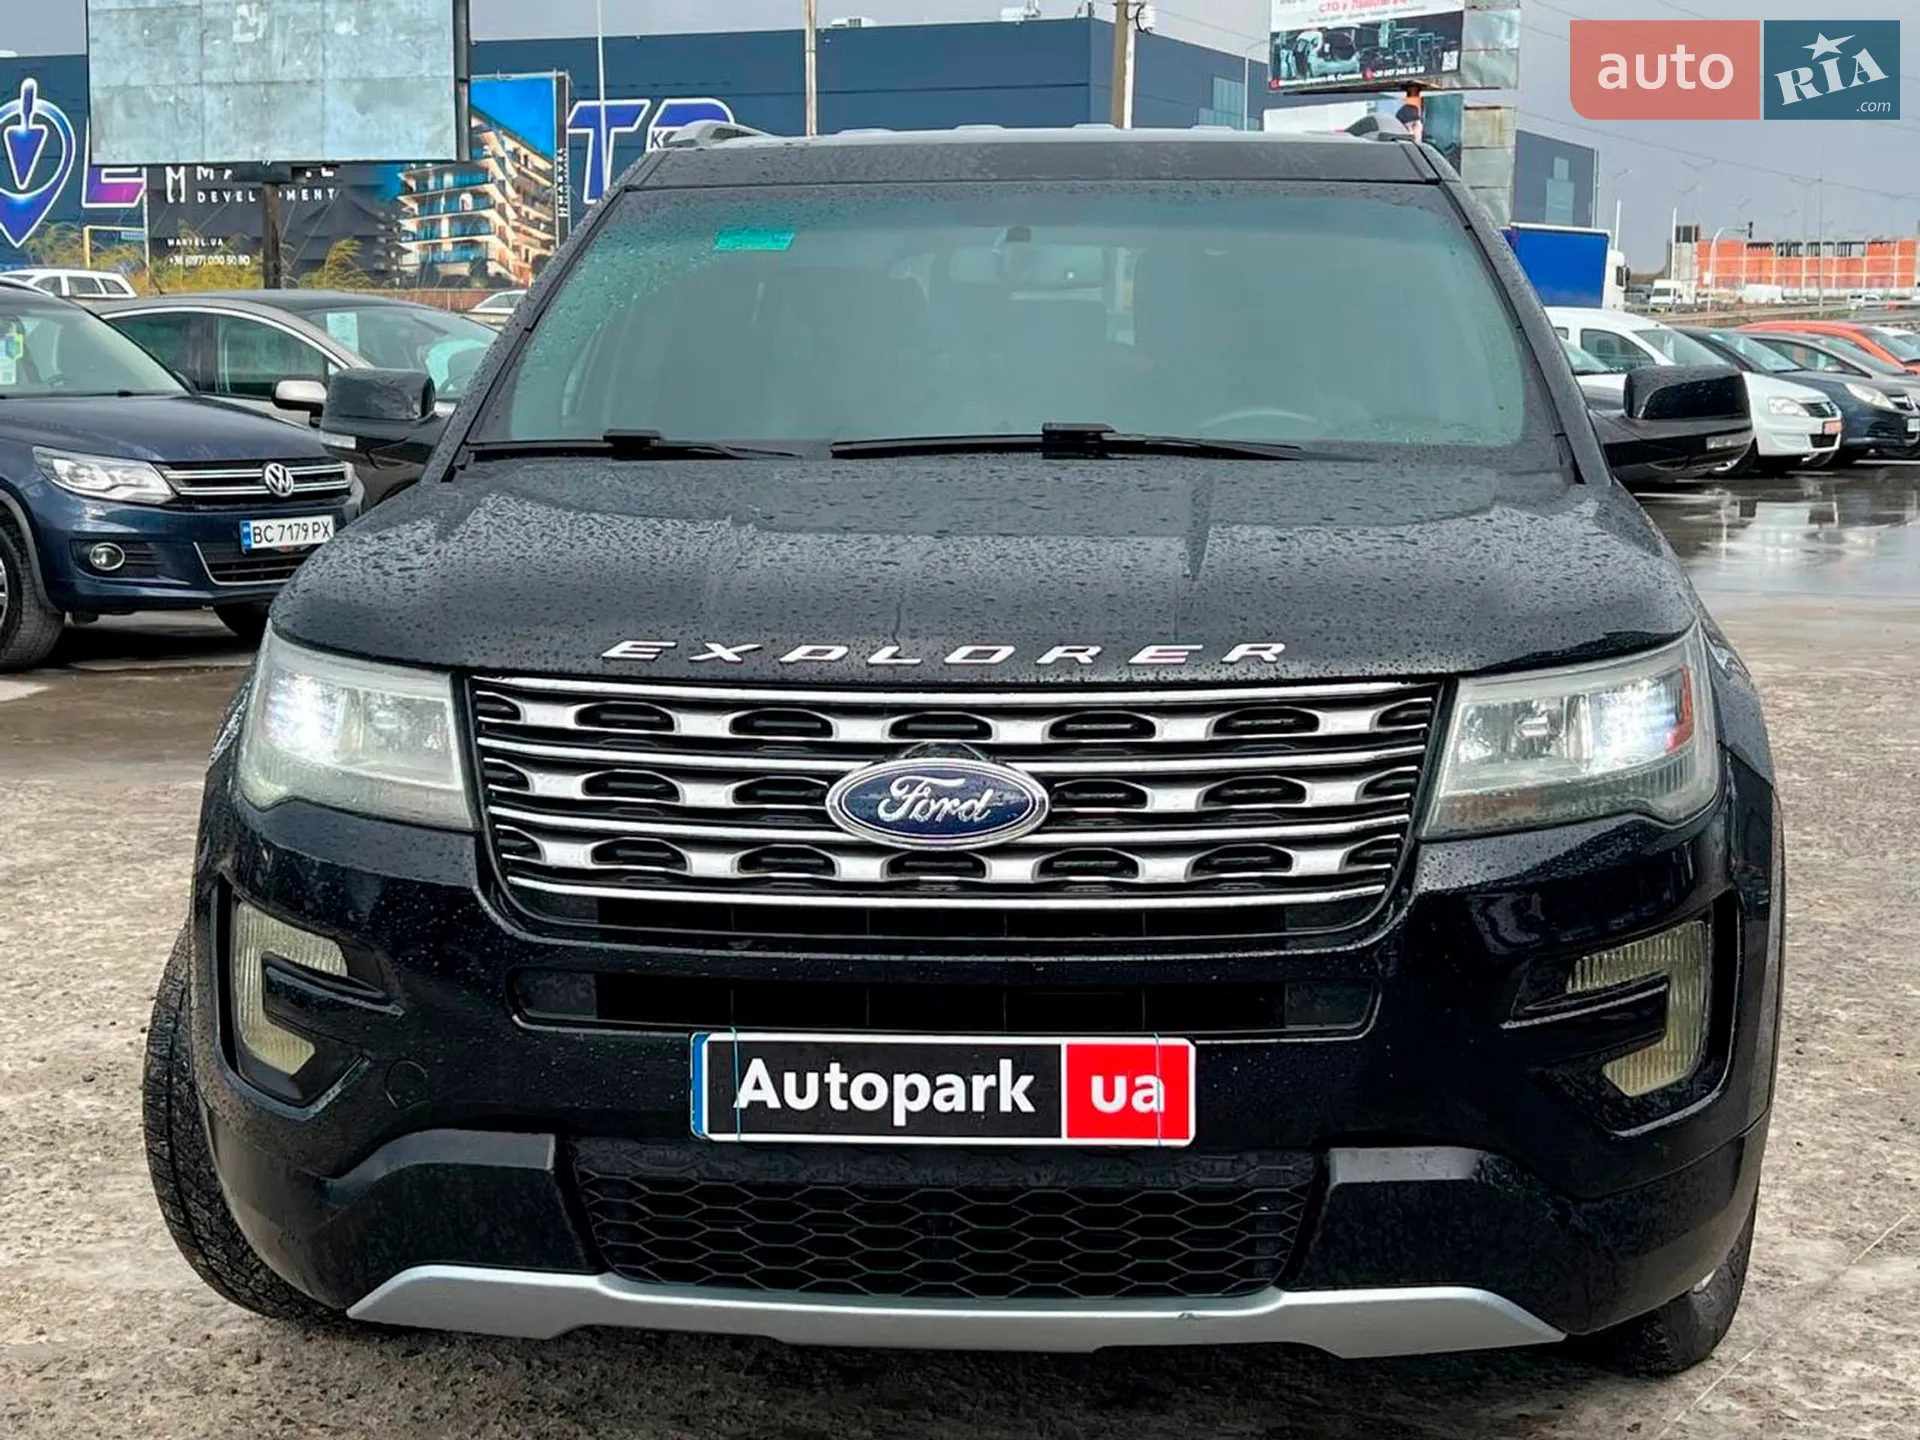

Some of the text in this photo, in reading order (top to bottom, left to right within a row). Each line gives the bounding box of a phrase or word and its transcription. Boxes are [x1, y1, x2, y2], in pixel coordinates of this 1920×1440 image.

[197, 188, 336, 203] DEVELMENT
[253, 521, 331, 544] BC 7179 PX
[602, 639, 1288, 667] EXPLORER
[877, 775, 997, 824] Ford
[733, 1056, 1166, 1127] Autopark ua
